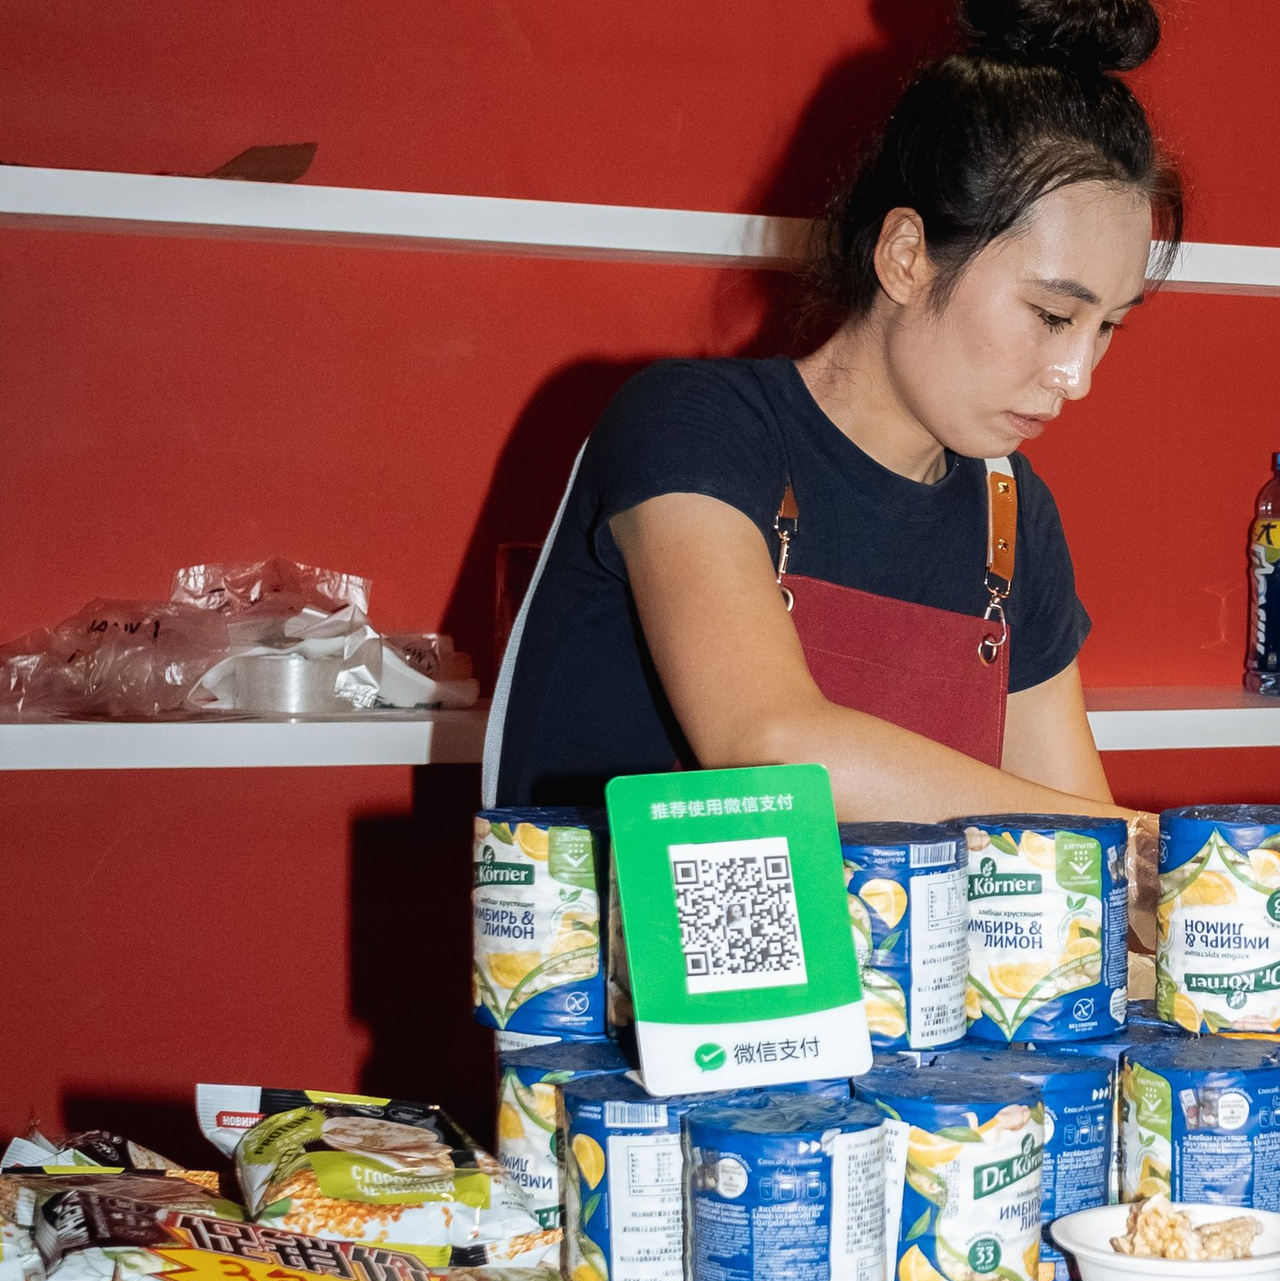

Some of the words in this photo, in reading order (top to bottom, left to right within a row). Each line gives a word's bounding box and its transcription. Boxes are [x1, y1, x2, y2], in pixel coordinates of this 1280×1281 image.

[651, 793, 794, 820] 推荐使用微信支付
[479, 867, 528, 883] Körner
[975, 874, 1036, 895] Körner
[521, 910, 535, 926] &
[1028, 918, 1042, 935] &
[483, 923, 535, 940] ЛИМОН
[1185, 919, 1243, 935] ЛИМОН
[983, 934, 1043, 950] ЛИМОН
[1185, 932, 1196, 947] &
[1200, 934, 1270, 949] ИМБИРЬ
[1190, 972, 1256, 991] Körner
[733, 1036, 820, 1065] 微信支付
[254, 1113, 312, 1156] PROTEIN
[982, 1166, 1010, 1193] Dr.
[976, 1247, 995, 1264] 33
